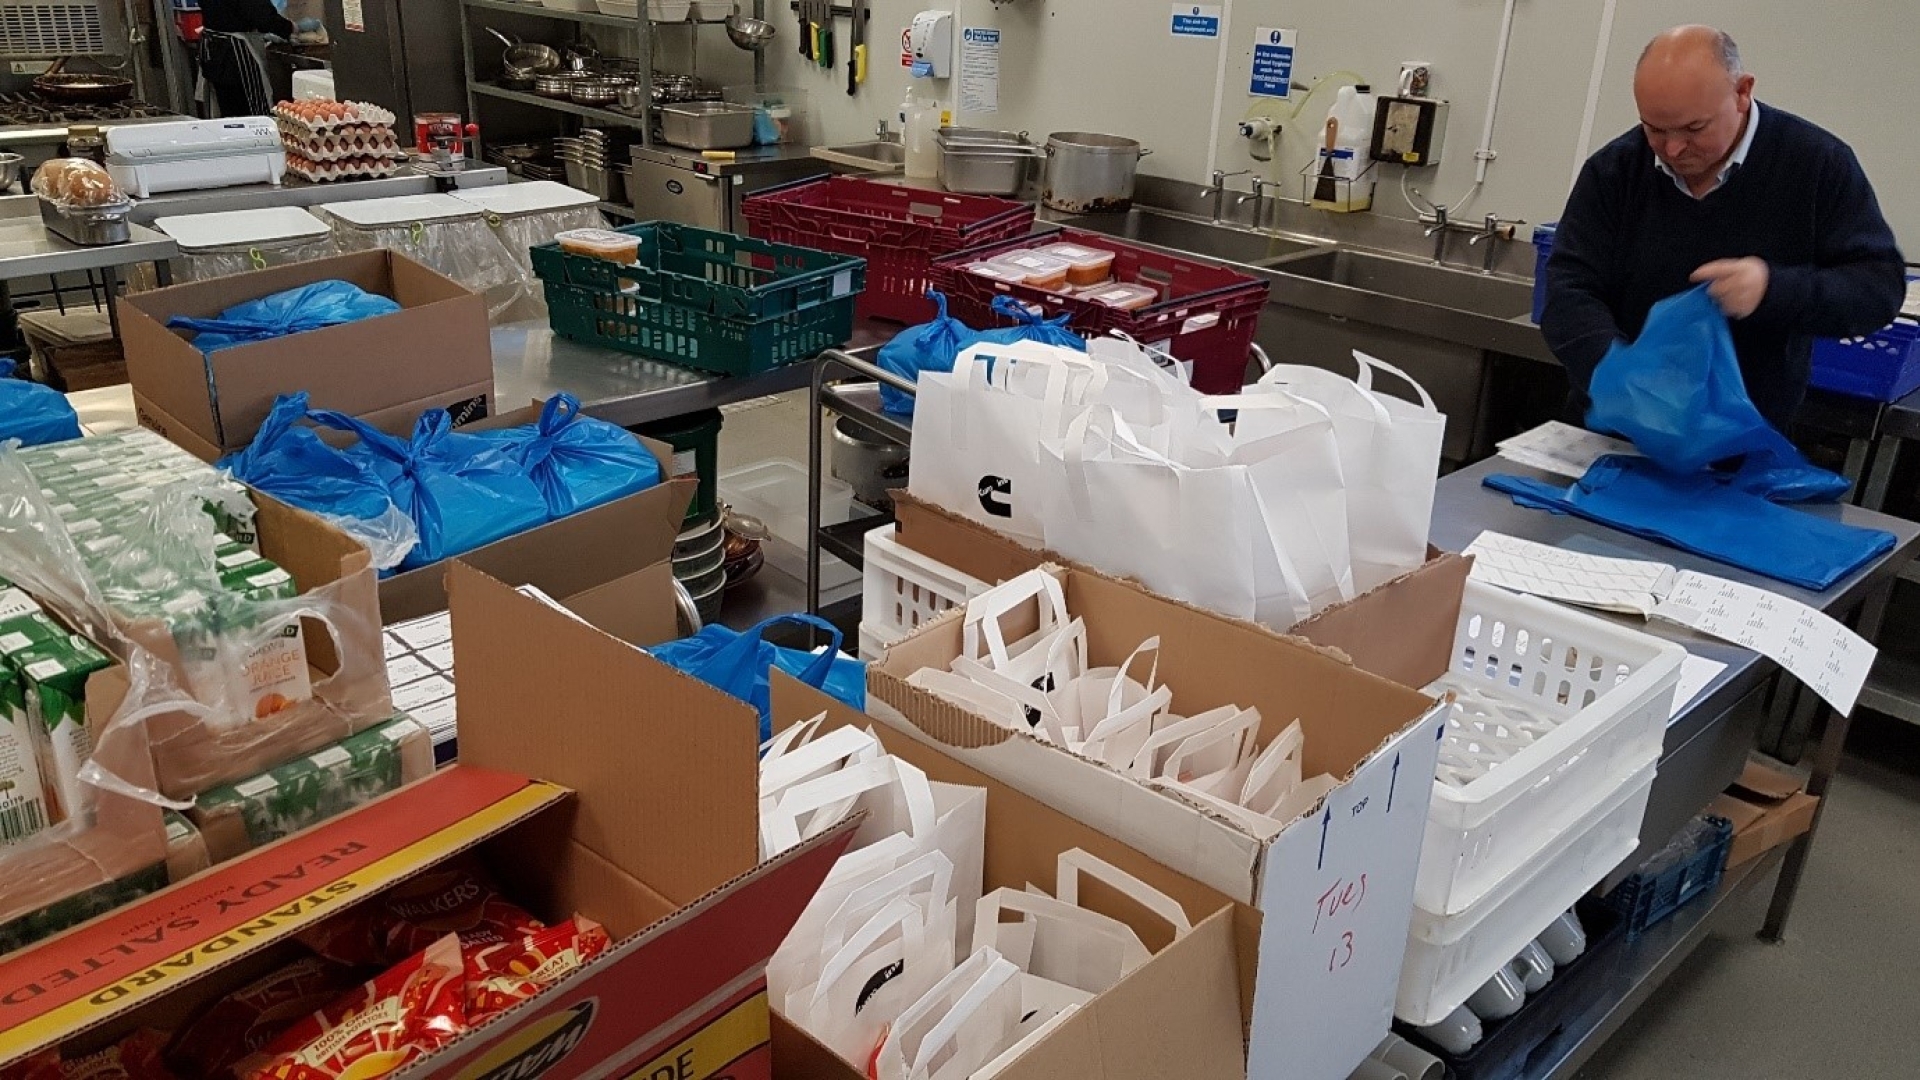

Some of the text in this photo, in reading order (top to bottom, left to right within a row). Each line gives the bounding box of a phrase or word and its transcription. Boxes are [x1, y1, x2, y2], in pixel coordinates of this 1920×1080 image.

[1351, 795, 1370, 818] TOP
[217, 840, 368, 915] READY
[390, 877, 480, 918] WALKERS
[0, 914, 201, 1007] SALTED
[88, 879, 359, 1007] STANDARD
[312, 1026, 346, 1052] 100%
[342, 1001, 388, 1029] GREAT
[347, 1009, 390, 1038] POTATOES
